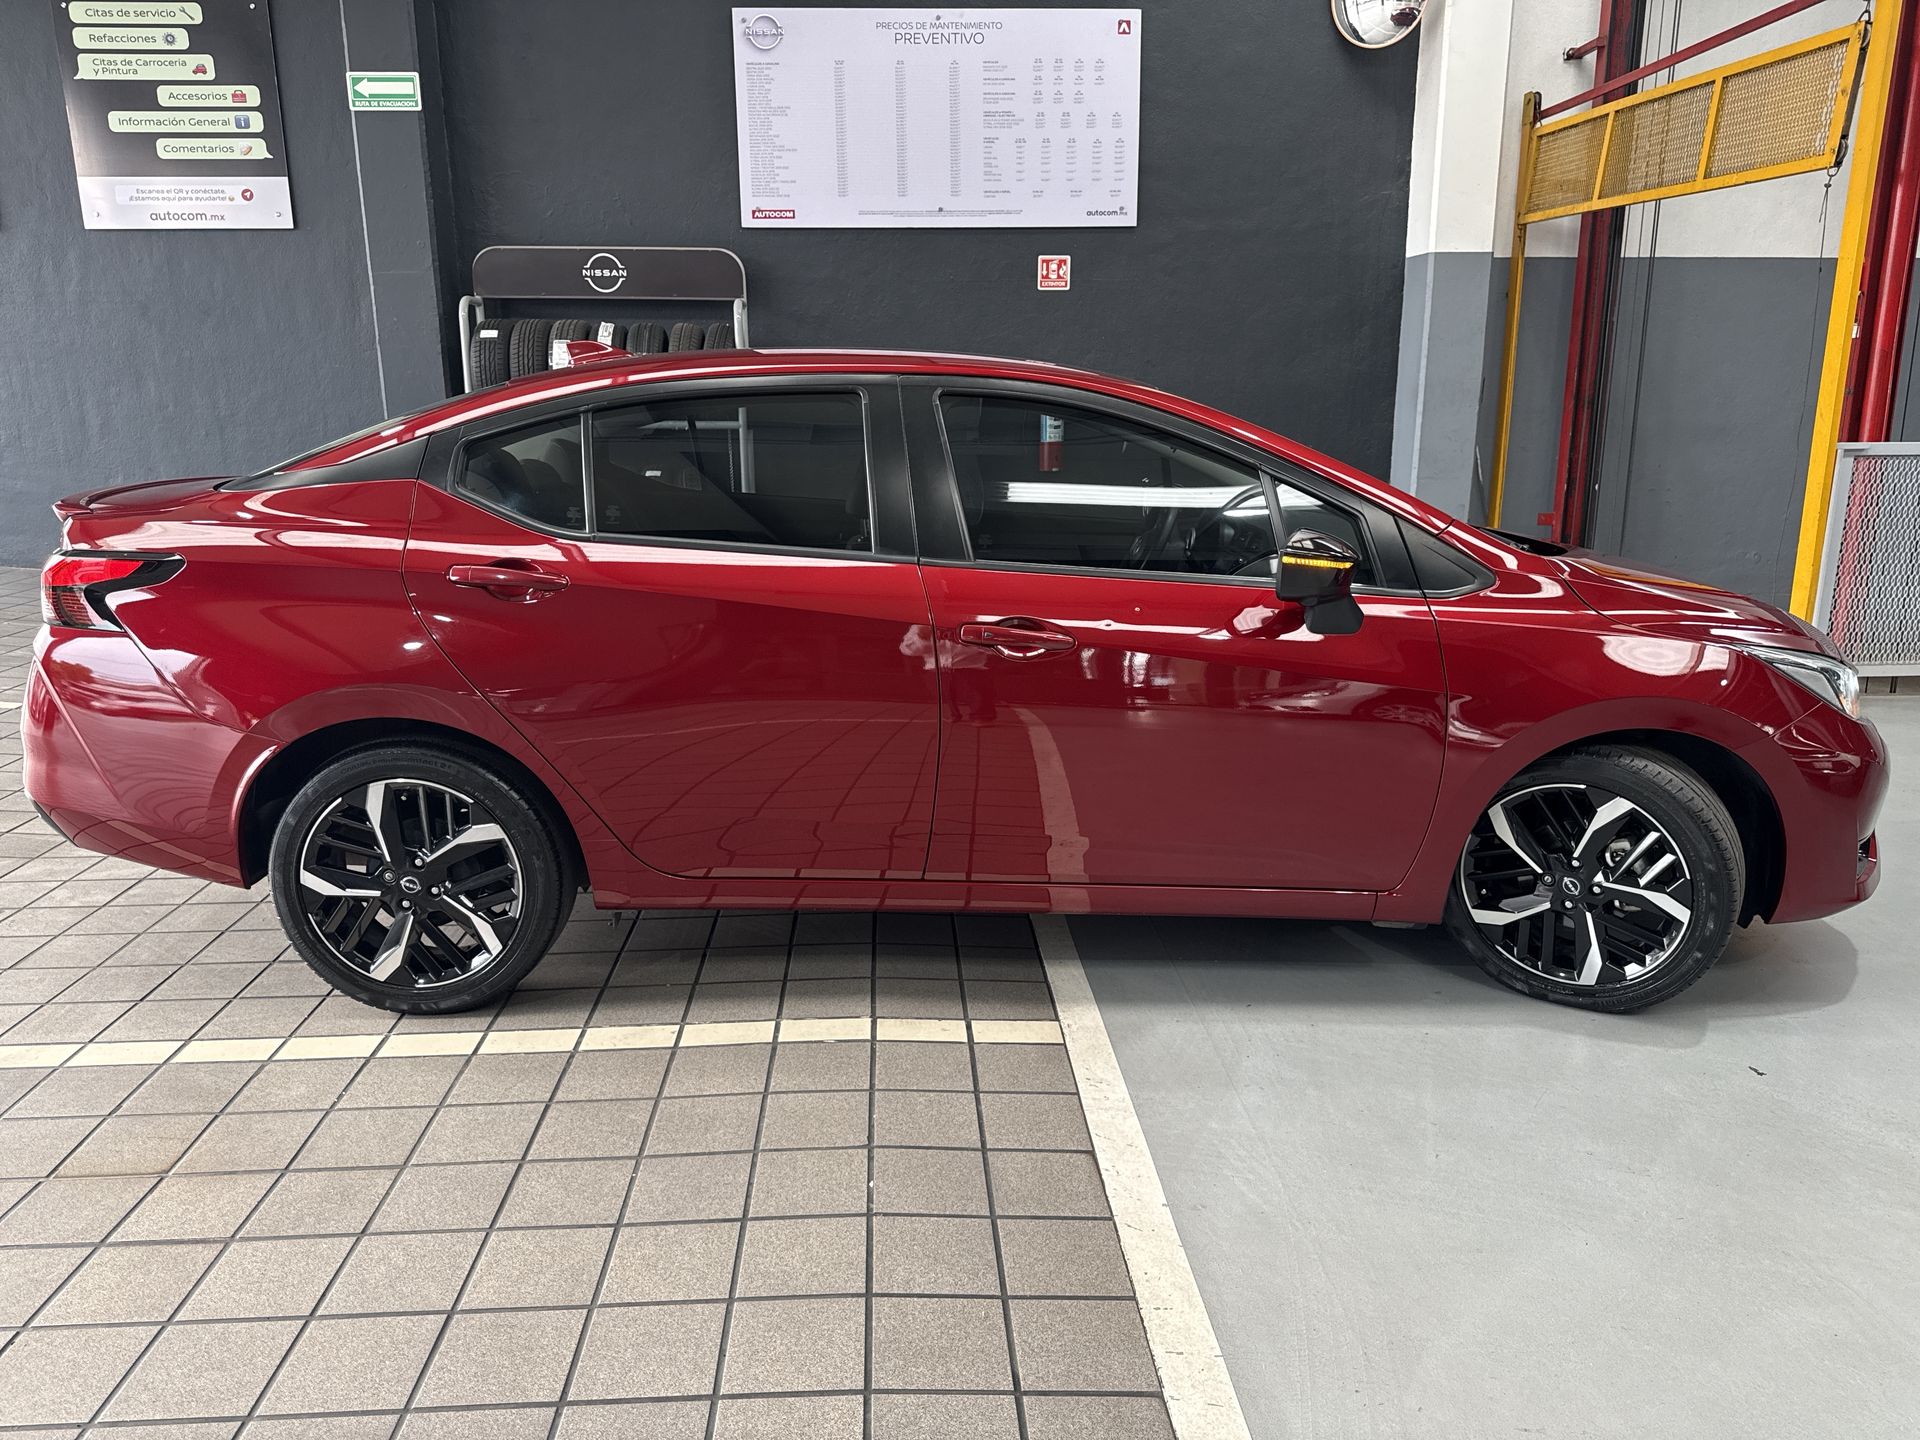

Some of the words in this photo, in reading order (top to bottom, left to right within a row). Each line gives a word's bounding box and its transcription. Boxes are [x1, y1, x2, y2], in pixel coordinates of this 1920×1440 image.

[85, 8, 114, 18] Citas
[117, 8, 130, 18] de
[133, 9, 176, 18] servicio
[88, 34, 157, 43] Refacciones
[895, 33, 984, 44] PREVENTIVO
[92, 58, 118, 66] Citas
[120, 58, 133, 66] de
[102, 67, 138, 75] Pintura
[168, 91, 228, 101] Accesorios
[118, 117, 185, 127] Información
[188, 117, 230, 127] General
[163, 143, 234, 154] Comentarios
[150, 211, 225, 221] autocom.mx
